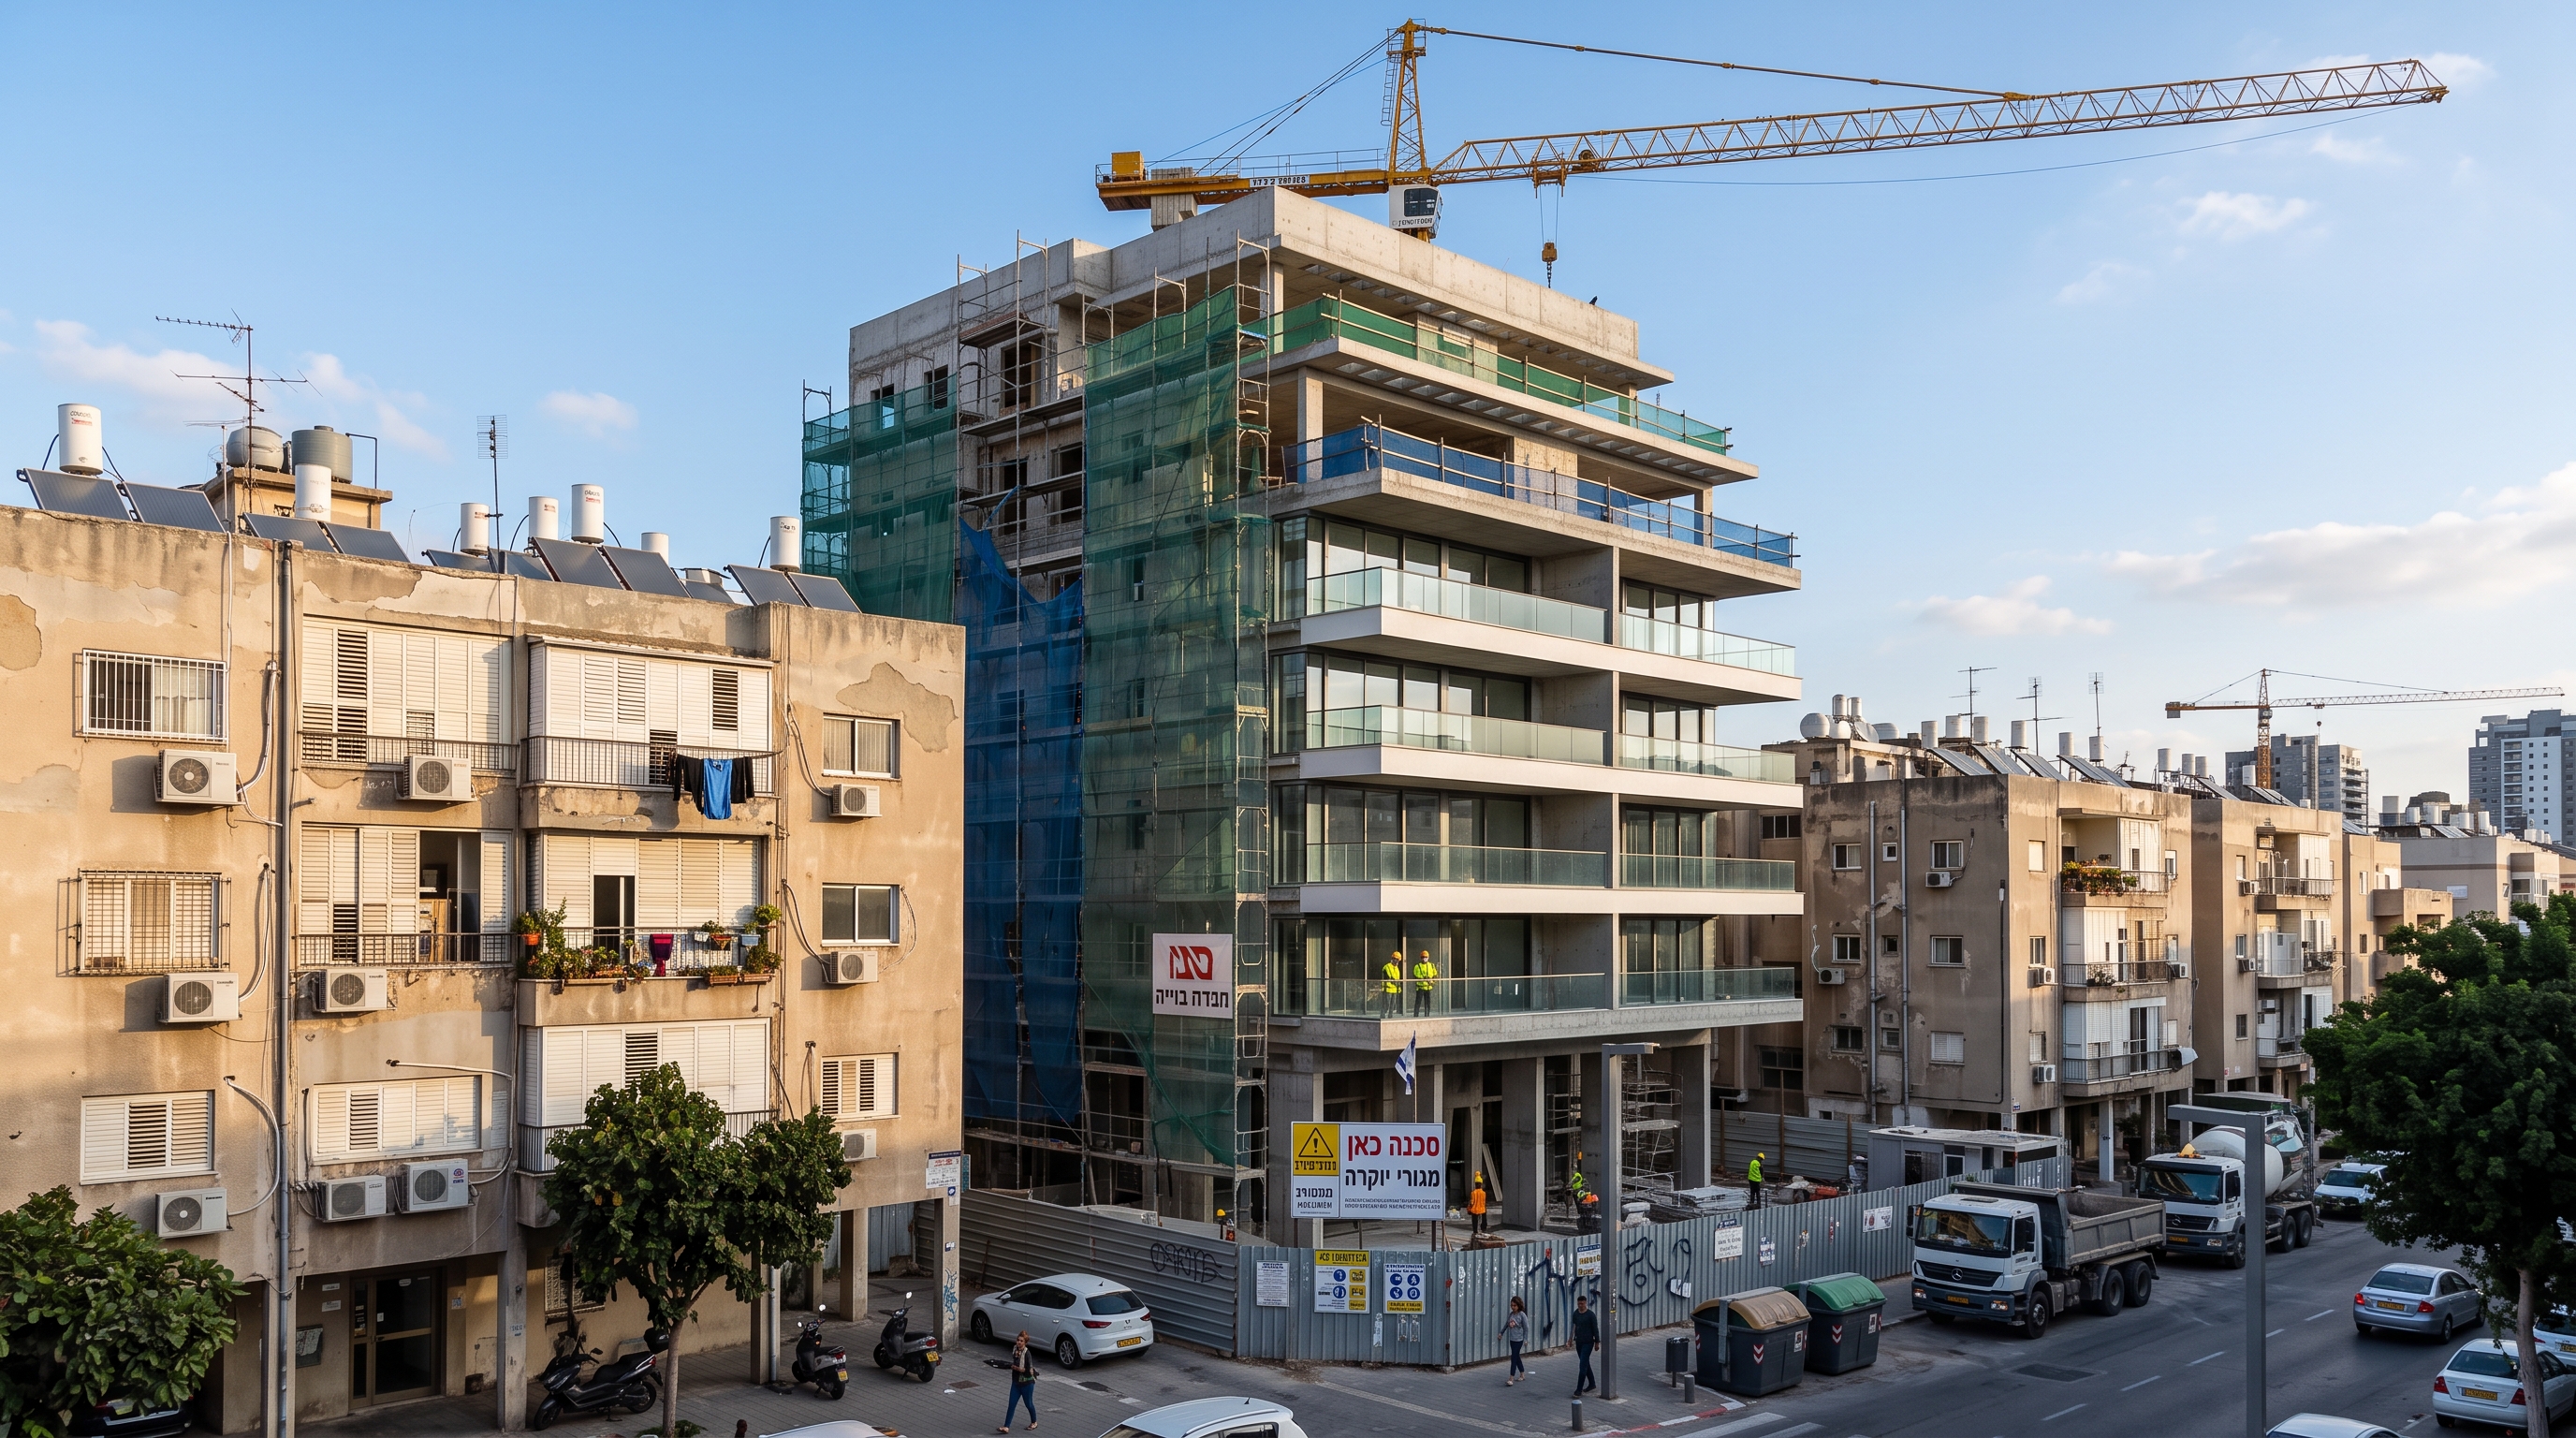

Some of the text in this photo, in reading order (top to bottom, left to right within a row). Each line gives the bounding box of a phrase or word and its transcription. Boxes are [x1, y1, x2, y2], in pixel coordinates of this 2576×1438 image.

[1348, 1135, 1441, 1161] סכנה כאן
[1345, 1169, 1441, 1191] מגורי יוקרה
